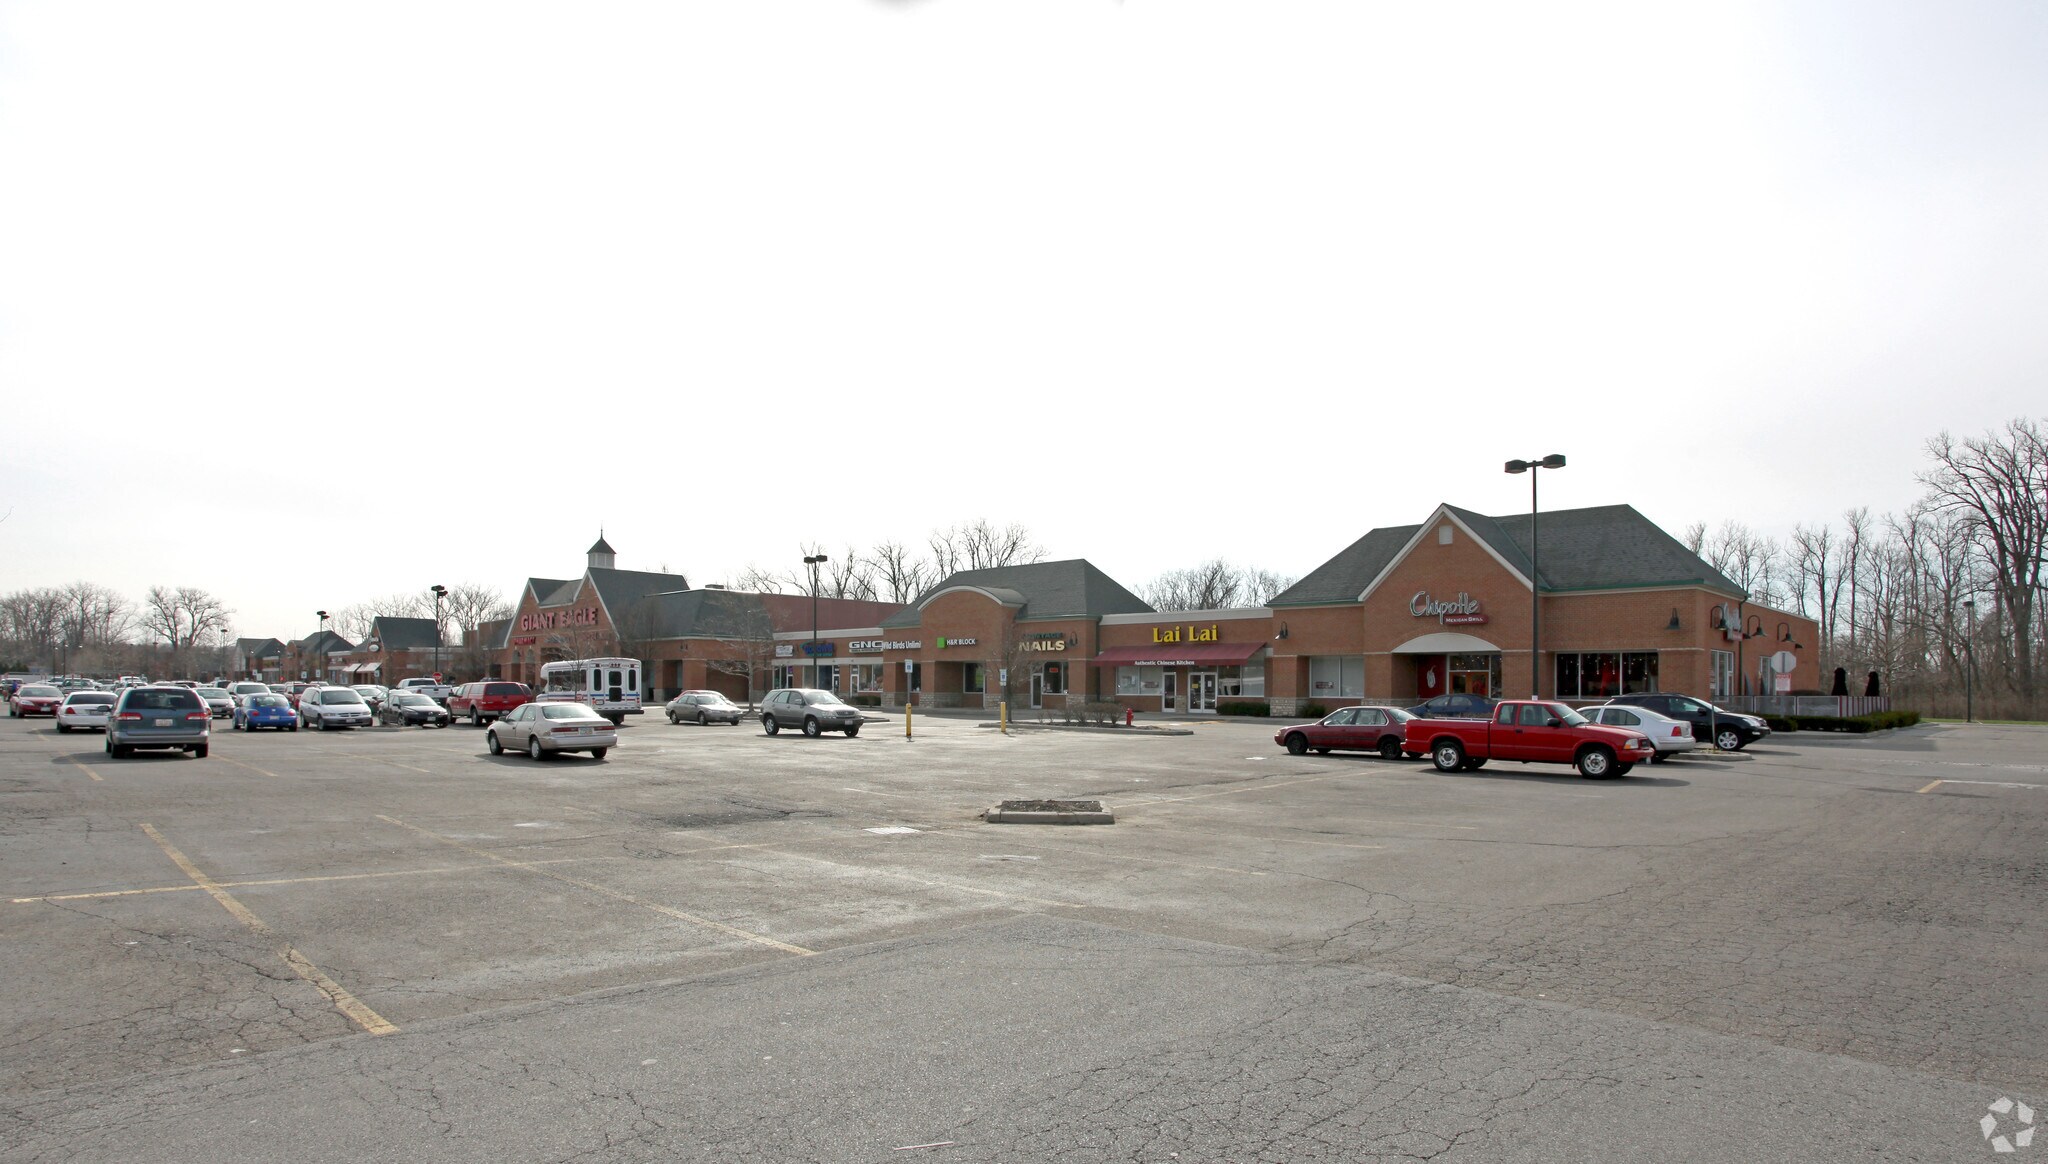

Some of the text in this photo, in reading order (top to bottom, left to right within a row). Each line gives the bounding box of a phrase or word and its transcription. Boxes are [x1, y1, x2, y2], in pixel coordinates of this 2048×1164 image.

[1409, 590, 1479, 625] Chipotle
[521, 611, 555, 632] GIANT
[1152, 624, 1218, 643] Lai Lai
[848, 640, 884, 649] GNC
[893, 640, 905, 650] Birds
[1018, 640, 1065, 651] NAILS
